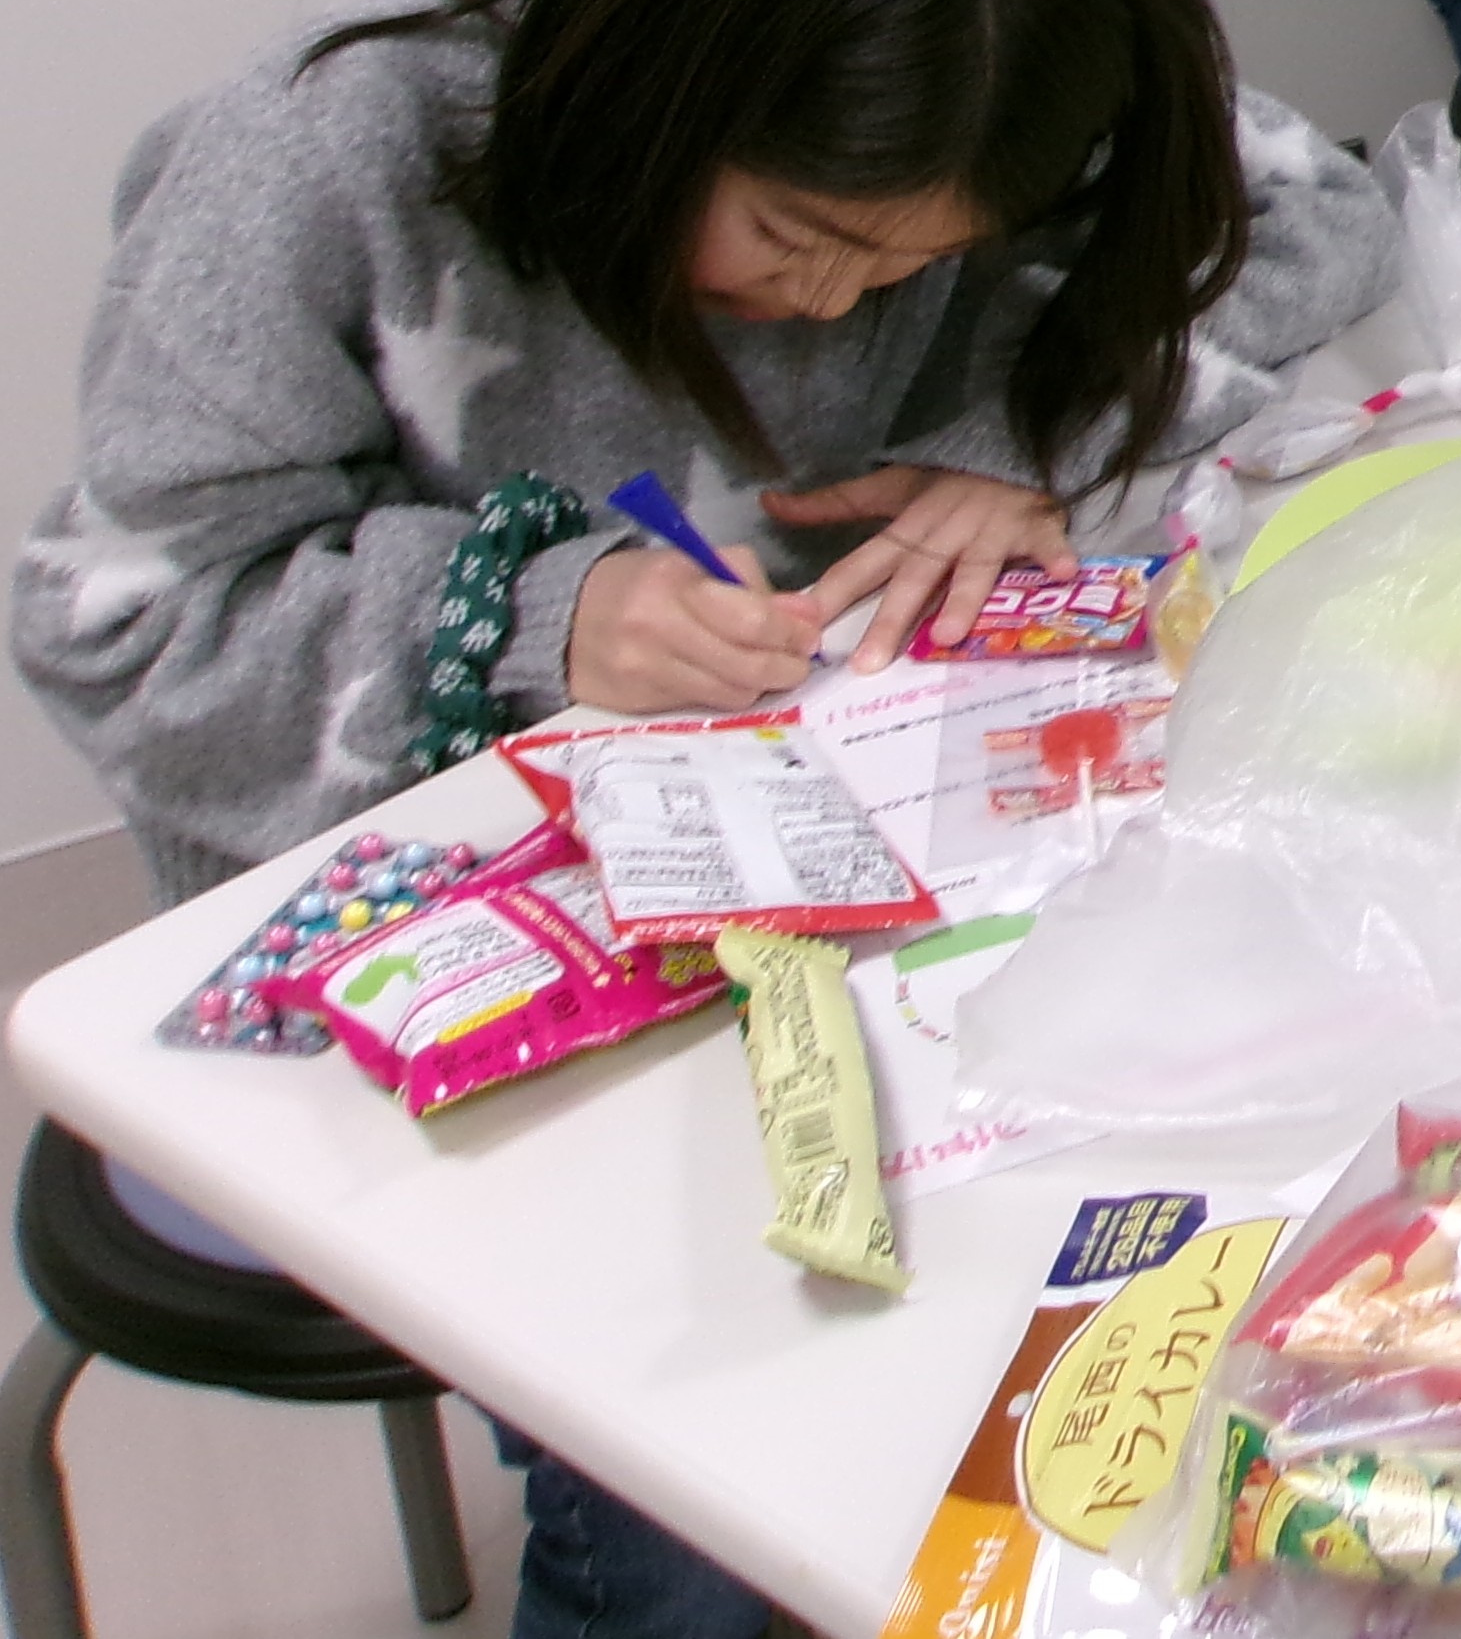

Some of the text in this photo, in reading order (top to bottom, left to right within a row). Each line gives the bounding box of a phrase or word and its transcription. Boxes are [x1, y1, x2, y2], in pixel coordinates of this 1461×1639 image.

[1051, 1321, 1137, 1452] 尾西の
[1083, 1235, 1234, 1518] ドライカレー
